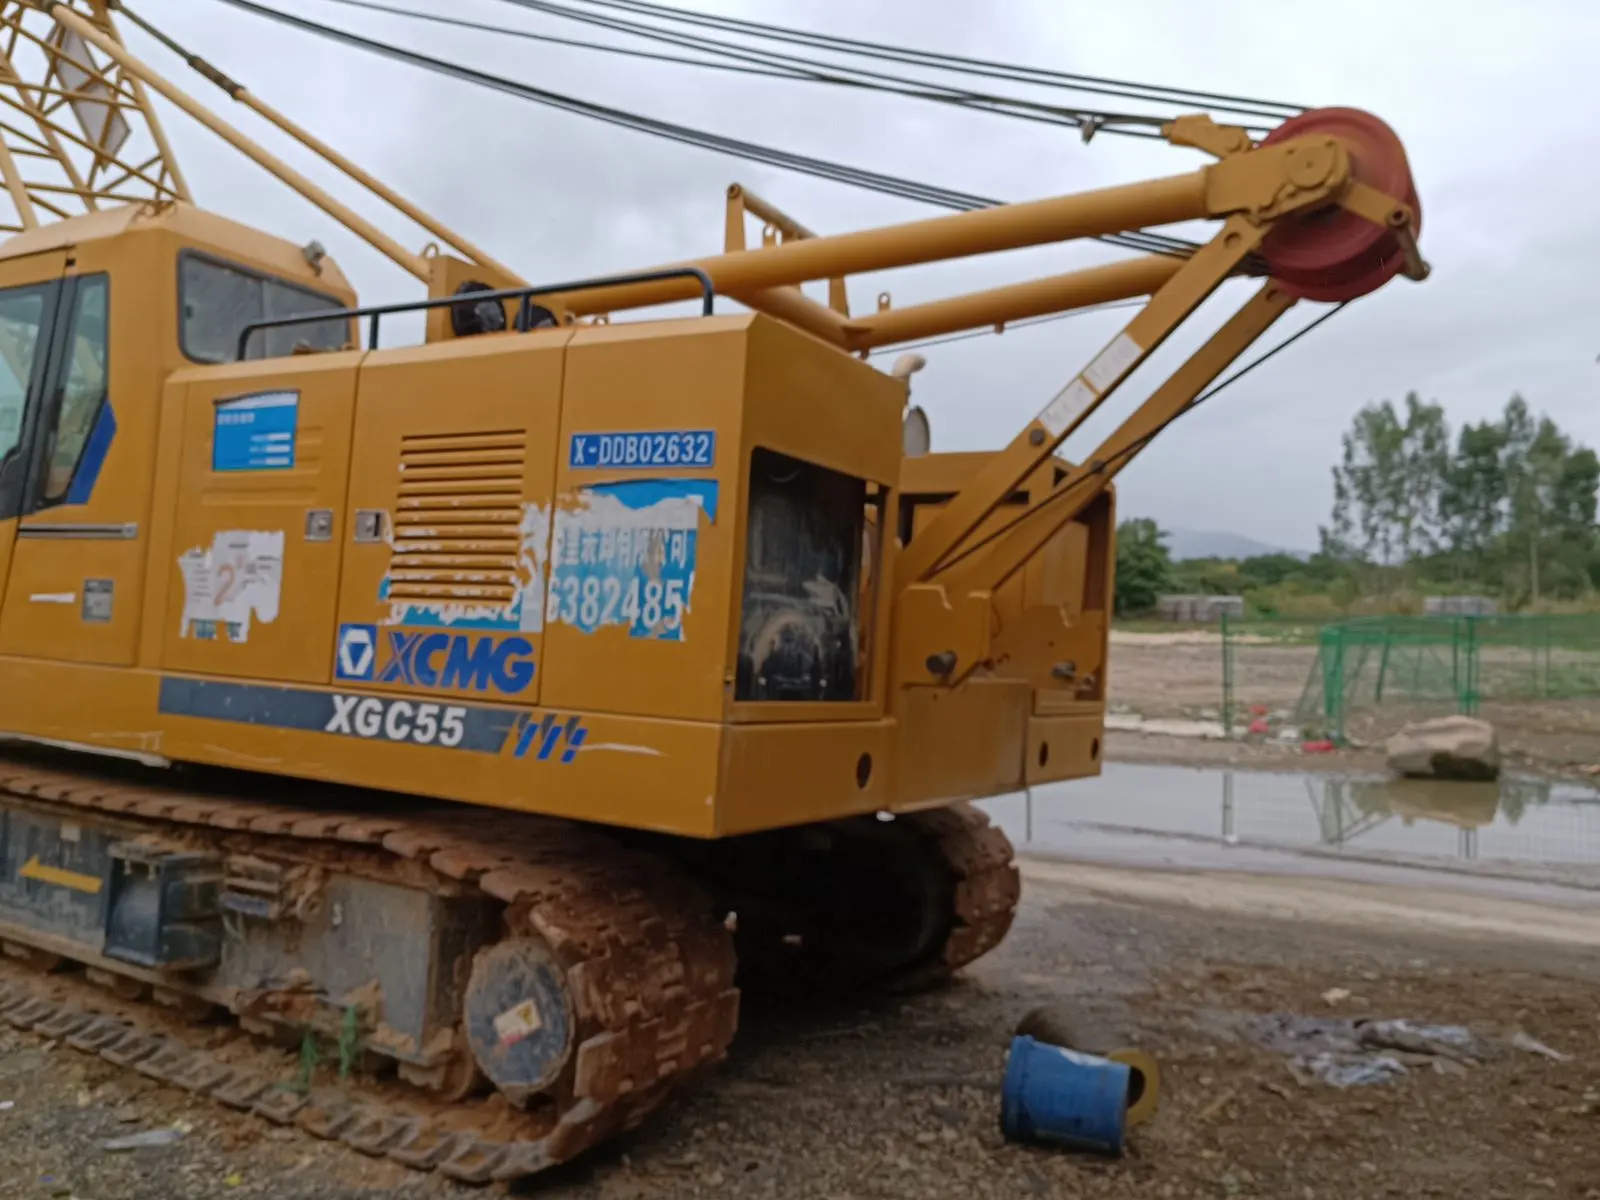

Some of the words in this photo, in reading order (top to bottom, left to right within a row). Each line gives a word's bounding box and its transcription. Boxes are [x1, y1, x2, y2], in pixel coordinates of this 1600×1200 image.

[573, 434, 710, 465] X-DDB02632
[375, 631, 535, 694] XCMG
[324, 694, 467, 746] XGC55
